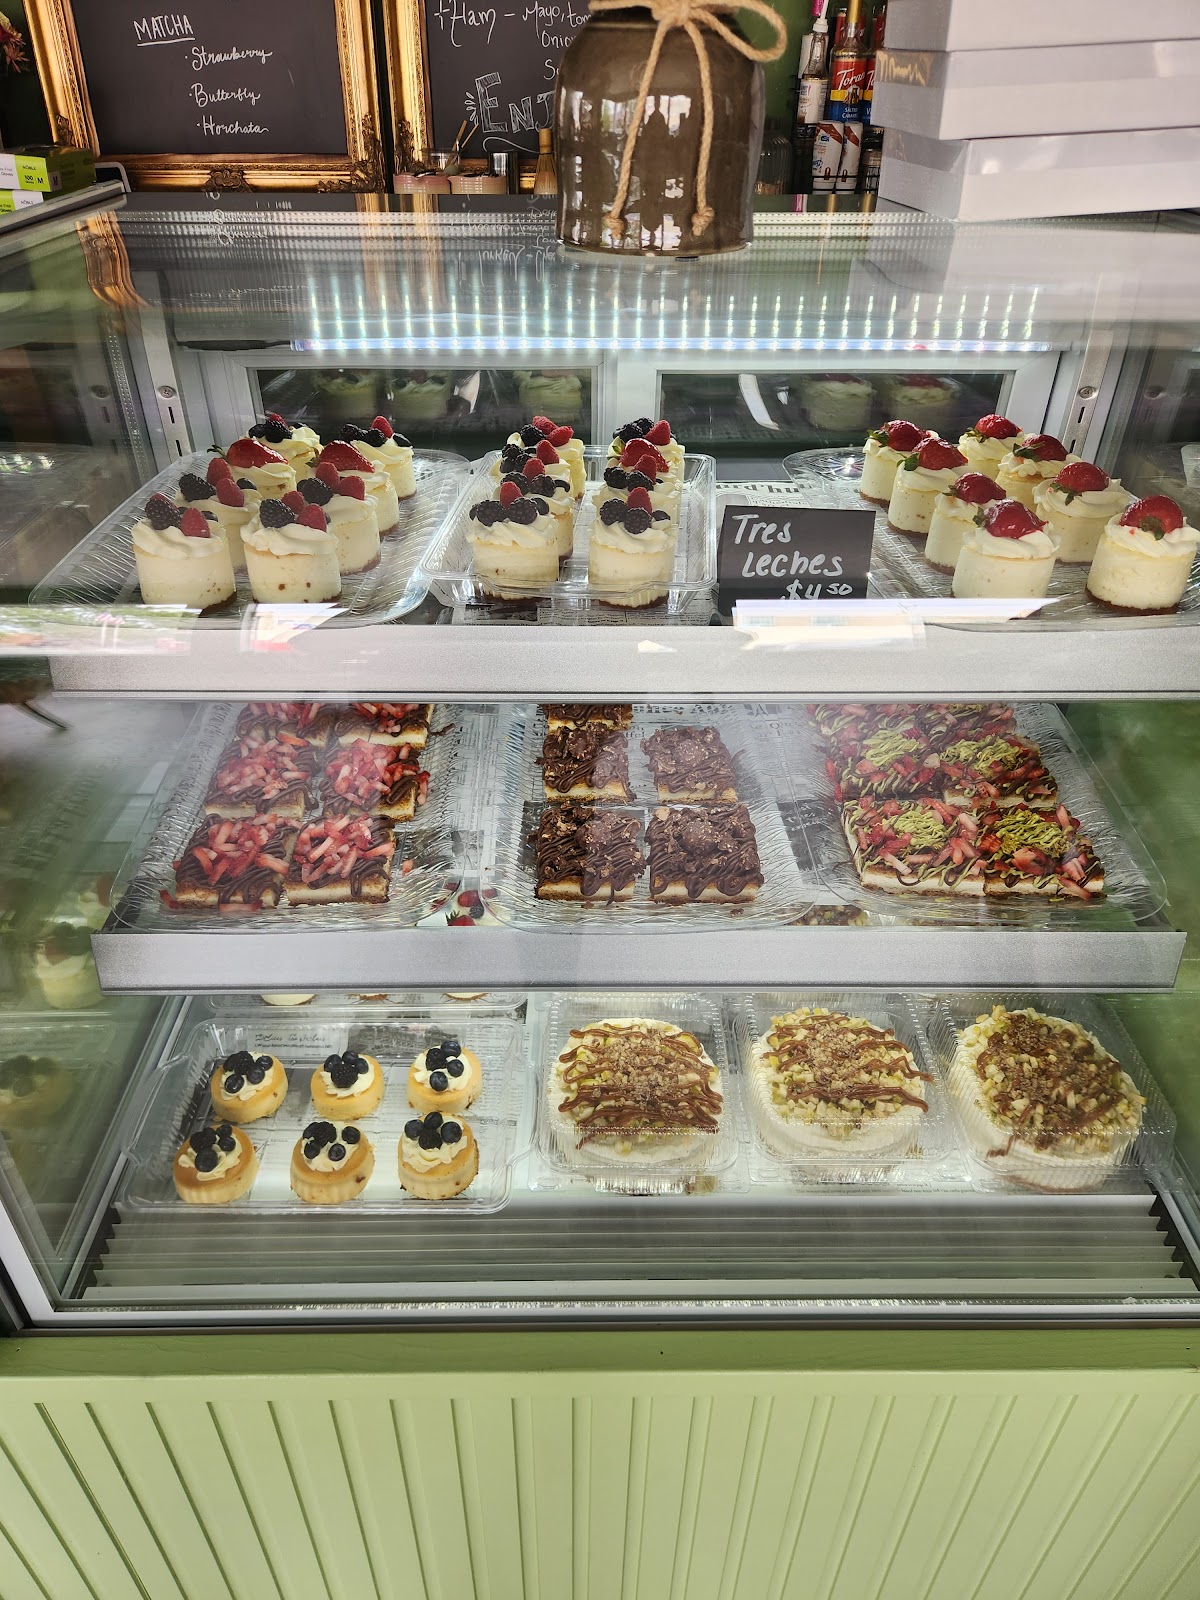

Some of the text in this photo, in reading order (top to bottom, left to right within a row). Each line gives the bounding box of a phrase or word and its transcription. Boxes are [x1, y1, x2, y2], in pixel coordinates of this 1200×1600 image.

[133, 14, 194, 41] MATCHA
[542, 30, 576, 49] Onio
[191, 47, 273, 71] Strawberry
[190, 83, 260, 107] Butterfly
[202, 115, 269, 136] Horchata
[731, 513, 792, 544] Tres
